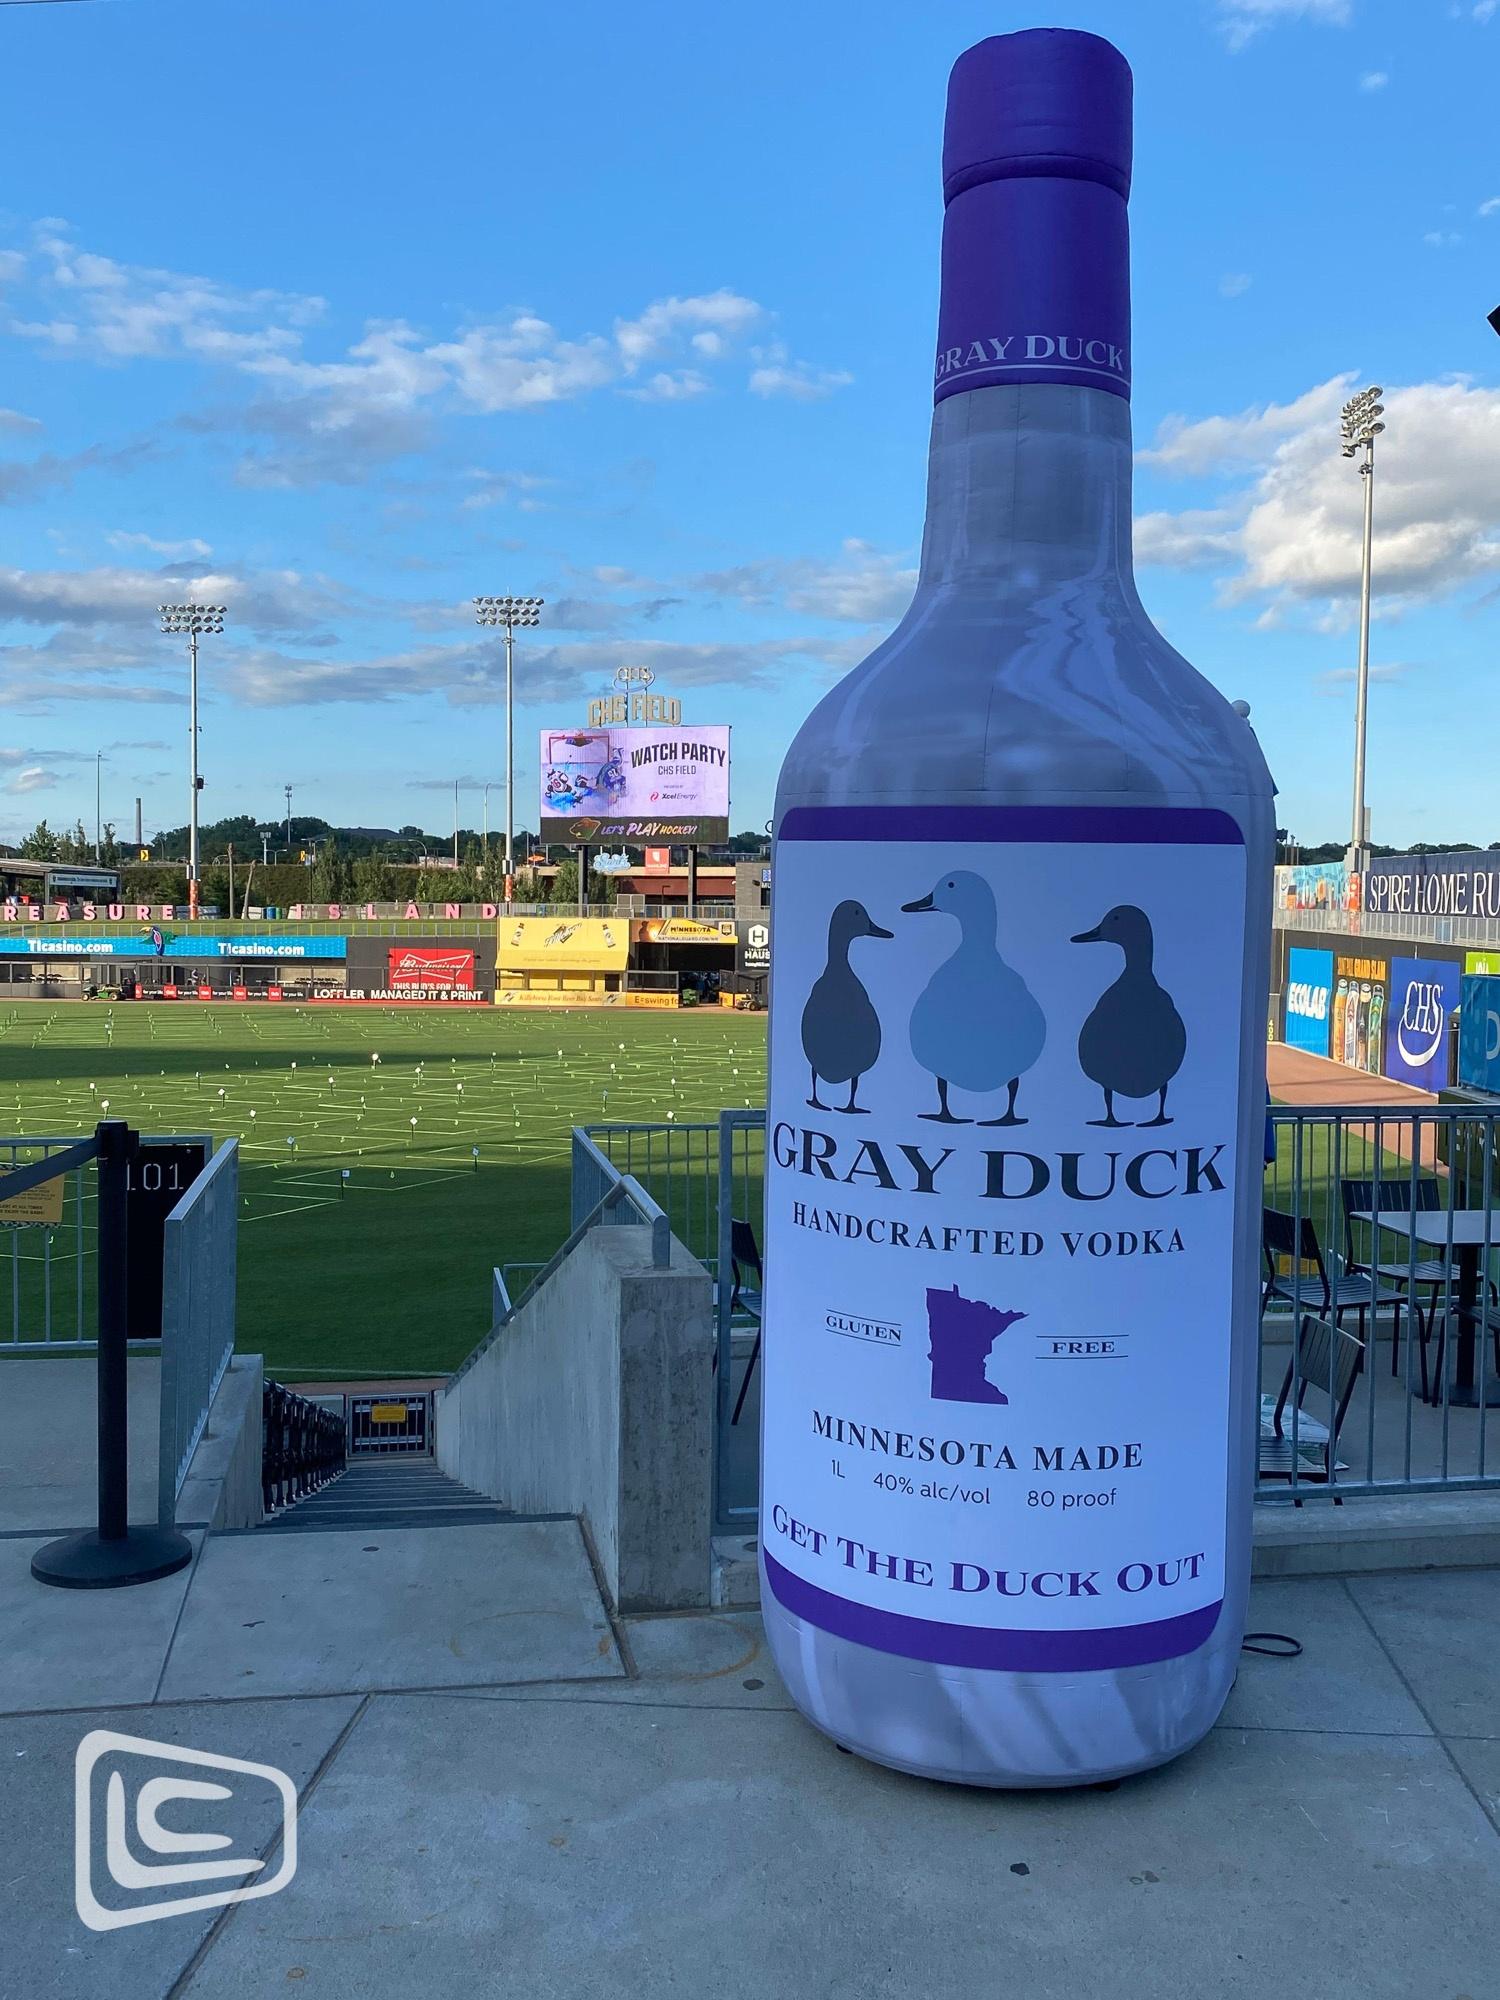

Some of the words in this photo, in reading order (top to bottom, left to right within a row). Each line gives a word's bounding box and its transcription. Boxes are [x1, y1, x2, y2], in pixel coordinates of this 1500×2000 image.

[935, 336, 1015, 379] GRAY
[1024, 335, 1124, 372] DUCK
[589, 695, 626, 727] CHS
[631, 694, 681, 725] FIELD
[631, 743, 678, 768] WATCH
[682, 742, 726, 767] PARTY
[658, 766, 674, 775] CHS
[676, 765, 697, 775] FIELD
[600, 826, 623, 835] LET'S
[626, 823, 660, 836] PLAY
[660, 826, 697, 834] HOCKEY!
[1369, 875, 1411, 912] SPIRE
[1415, 874, 1467, 914] HOME
[314, 989, 365, 999] LOFFLER
[370, 990, 426, 1000] MANAGED
[428, 991, 439, 1000] IT
[441, 991, 448, 1000] &
[450, 991, 483, 1000] PRINT
[1288, 982, 1328, 1020] ECOLAB
[1403, 981, 1441, 1035] CHS
[773, 1121, 956, 1194] GRAY
[979, 1144, 1227, 1200] DUCK
[792, 1201, 1044, 1256] HANDCRAFTED
[1062, 1227, 1186, 1257] VODKA
[826, 1315, 902, 1342] GLUTEN
[1053, 1341, 1115, 1353] FREE
[812, 1410, 1018, 1470] MINNESOTA
[1033, 1442, 1143, 1471] MADE
[831, 1459, 846, 1479] 1L
[873, 1472, 914, 1496] 40%
[919, 1480, 991, 1505] alc/vol
[1027, 1490, 1055, 1507] 80
[1061, 1487, 1117, 1511] proof
[772, 1504, 828, 1556] GET
[837, 1536, 934, 1587] THE
[949, 1562, 1102, 1597] DUCK
[1117, 1552, 1206, 1592] OUT
